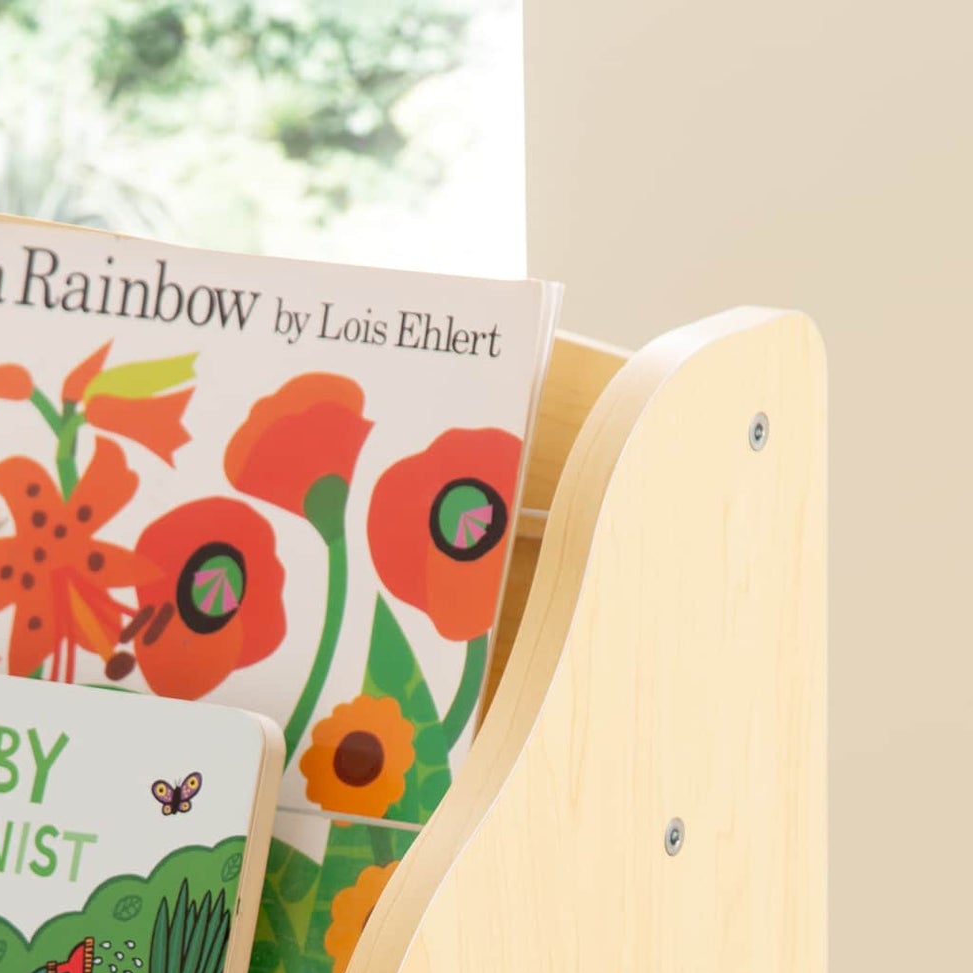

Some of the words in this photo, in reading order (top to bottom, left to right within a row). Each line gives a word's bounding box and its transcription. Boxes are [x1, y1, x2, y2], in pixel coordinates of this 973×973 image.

[14, 245, 262, 331] Rainbow
[274, 297, 311, 345] by
[316, 302, 387, 346] Lois
[394, 310, 503, 359] Ehlert
